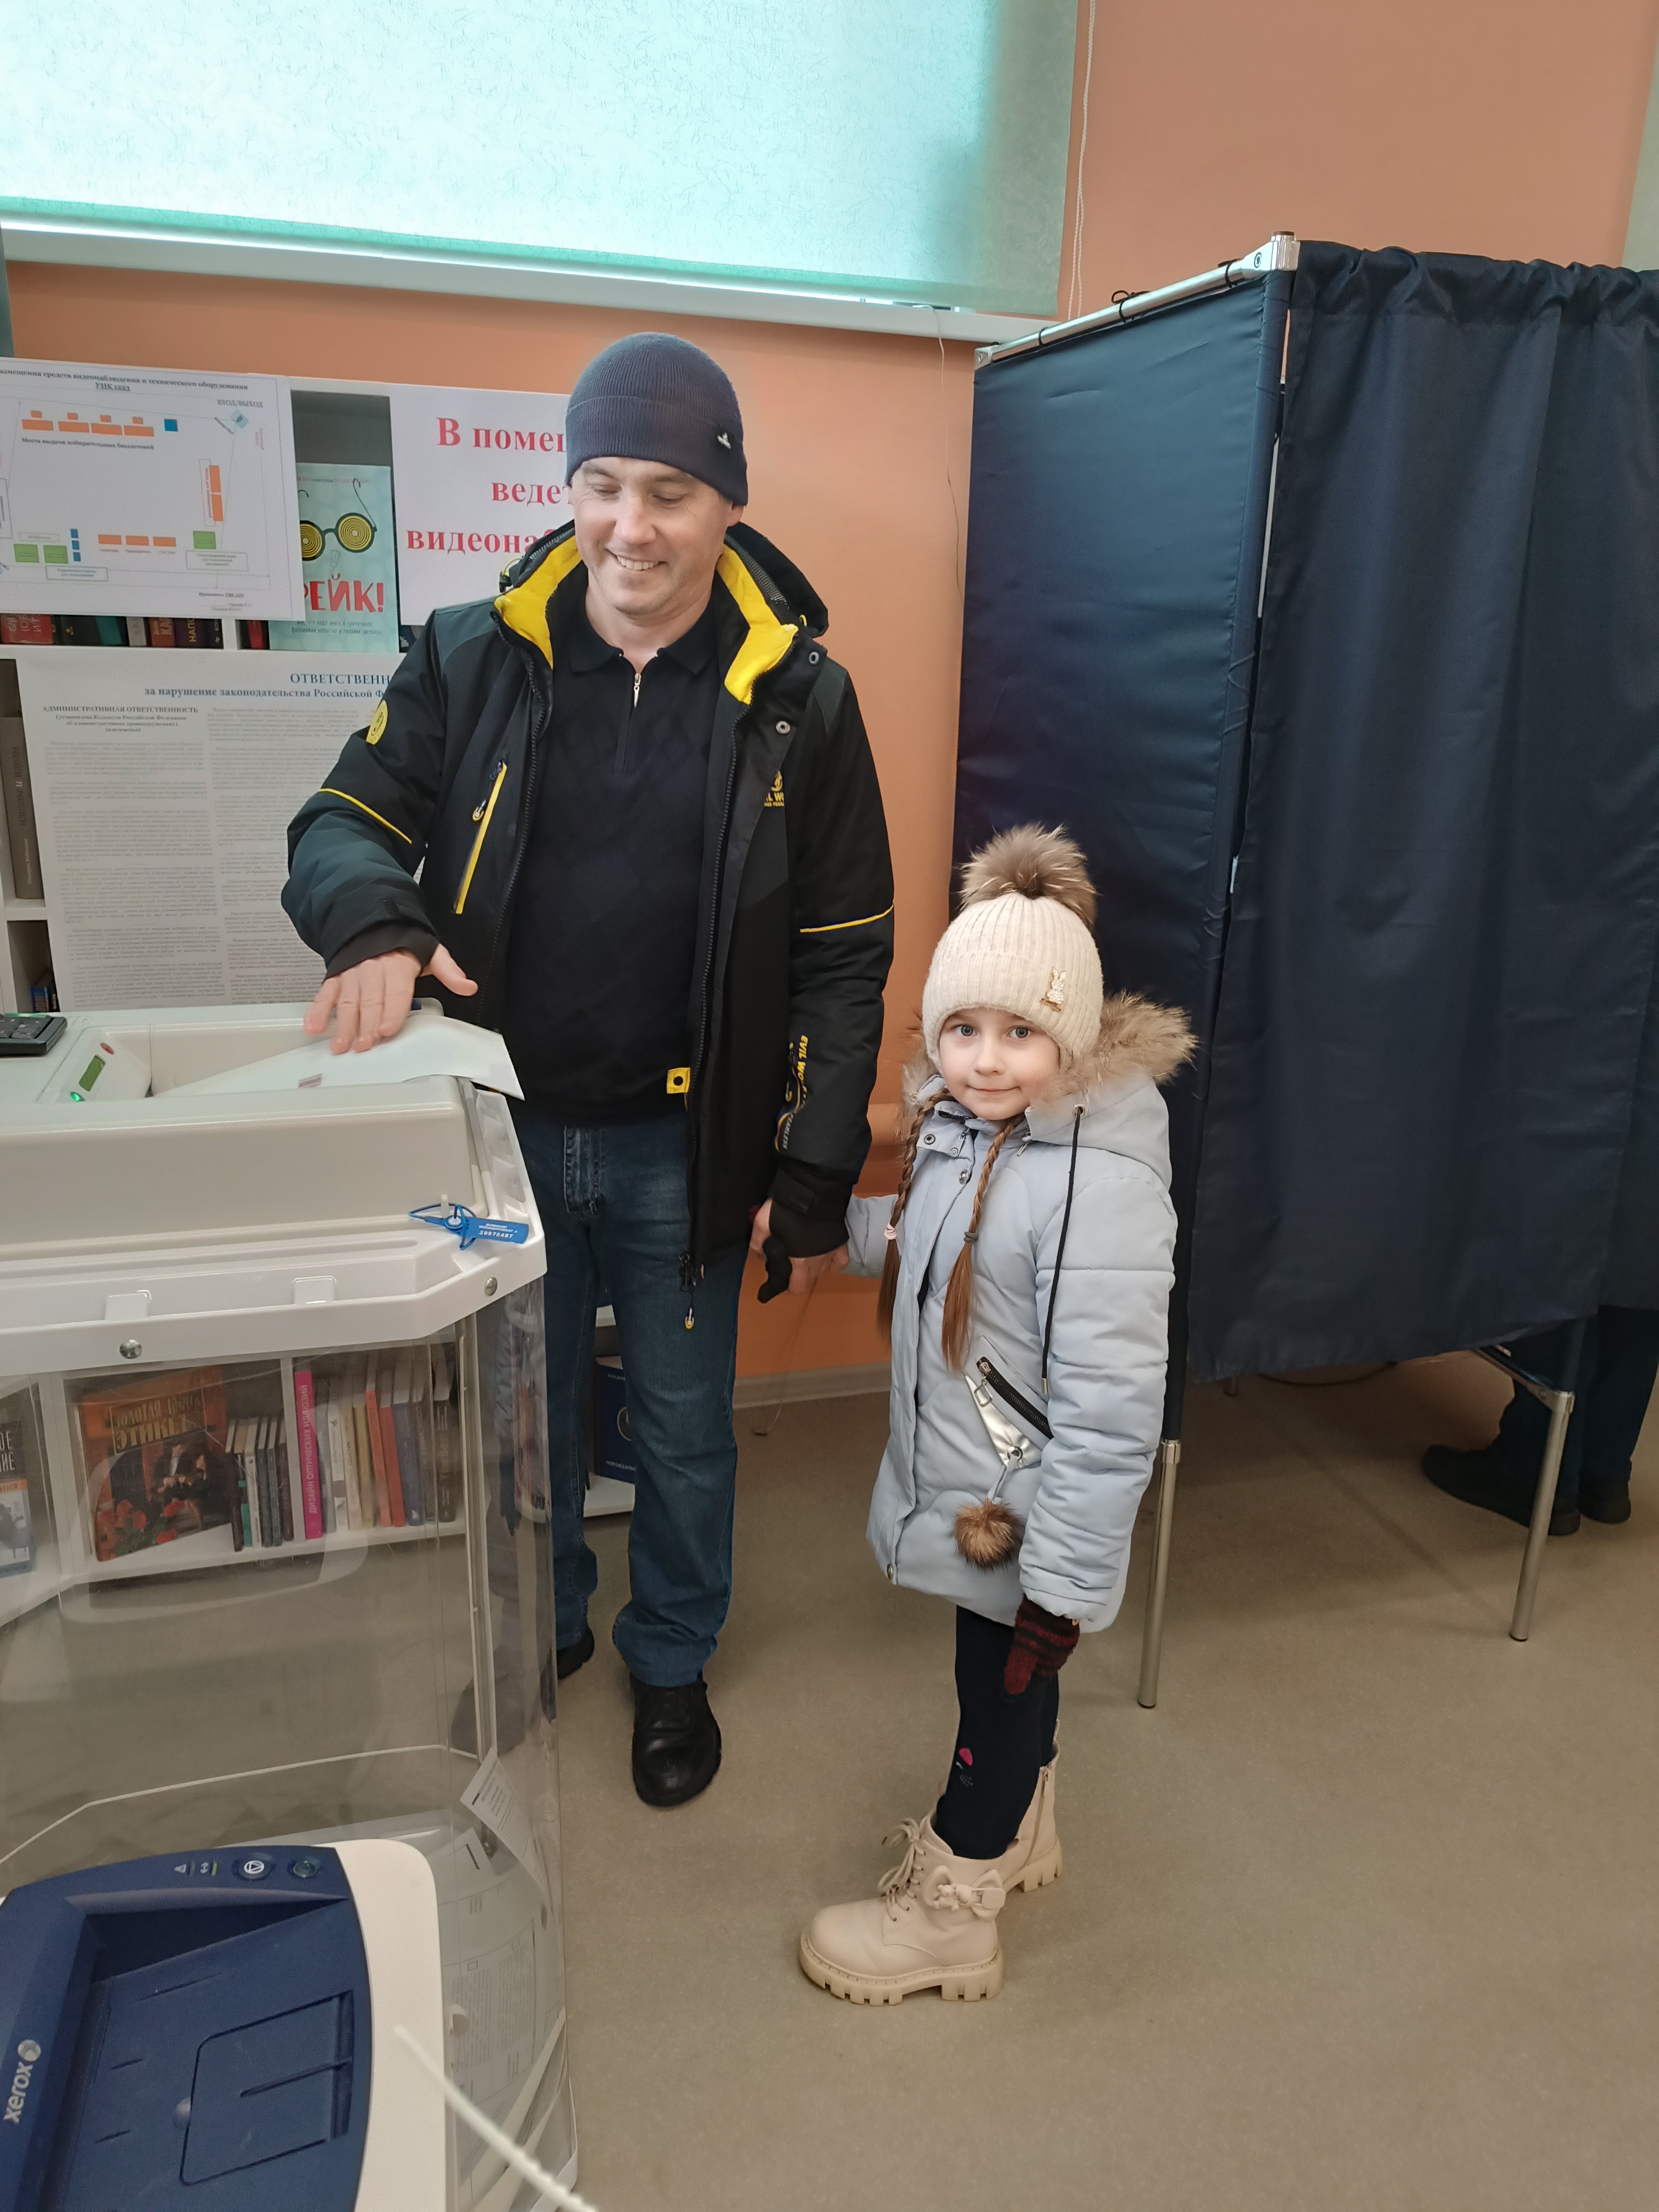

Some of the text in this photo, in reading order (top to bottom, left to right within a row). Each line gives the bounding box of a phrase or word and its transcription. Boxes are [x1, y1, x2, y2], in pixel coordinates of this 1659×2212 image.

[73, 375, 140, 384] видеонаблюдения
[148, 378, 197, 387] технического
[198, 382, 248, 390] оборудования
[217, 399, 263, 408] ВХОД/ВЫХОД
[436, 417, 461, 447] В
[67, 440, 116, 449] избирательных
[406, 530, 555, 556] видеона
[158, 688, 217, 697] нарушение
[220, 690, 311, 698] законодательства
[314, 689, 372, 698] Российской
[799, 1035, 808, 1058] EVIL
[300, 1384, 317, 1514] ДИЗАЙН ОПТИЧЕСКИХ ИЛЛЮЗИЙ
[4, 2061, 32, 2122] xerox
